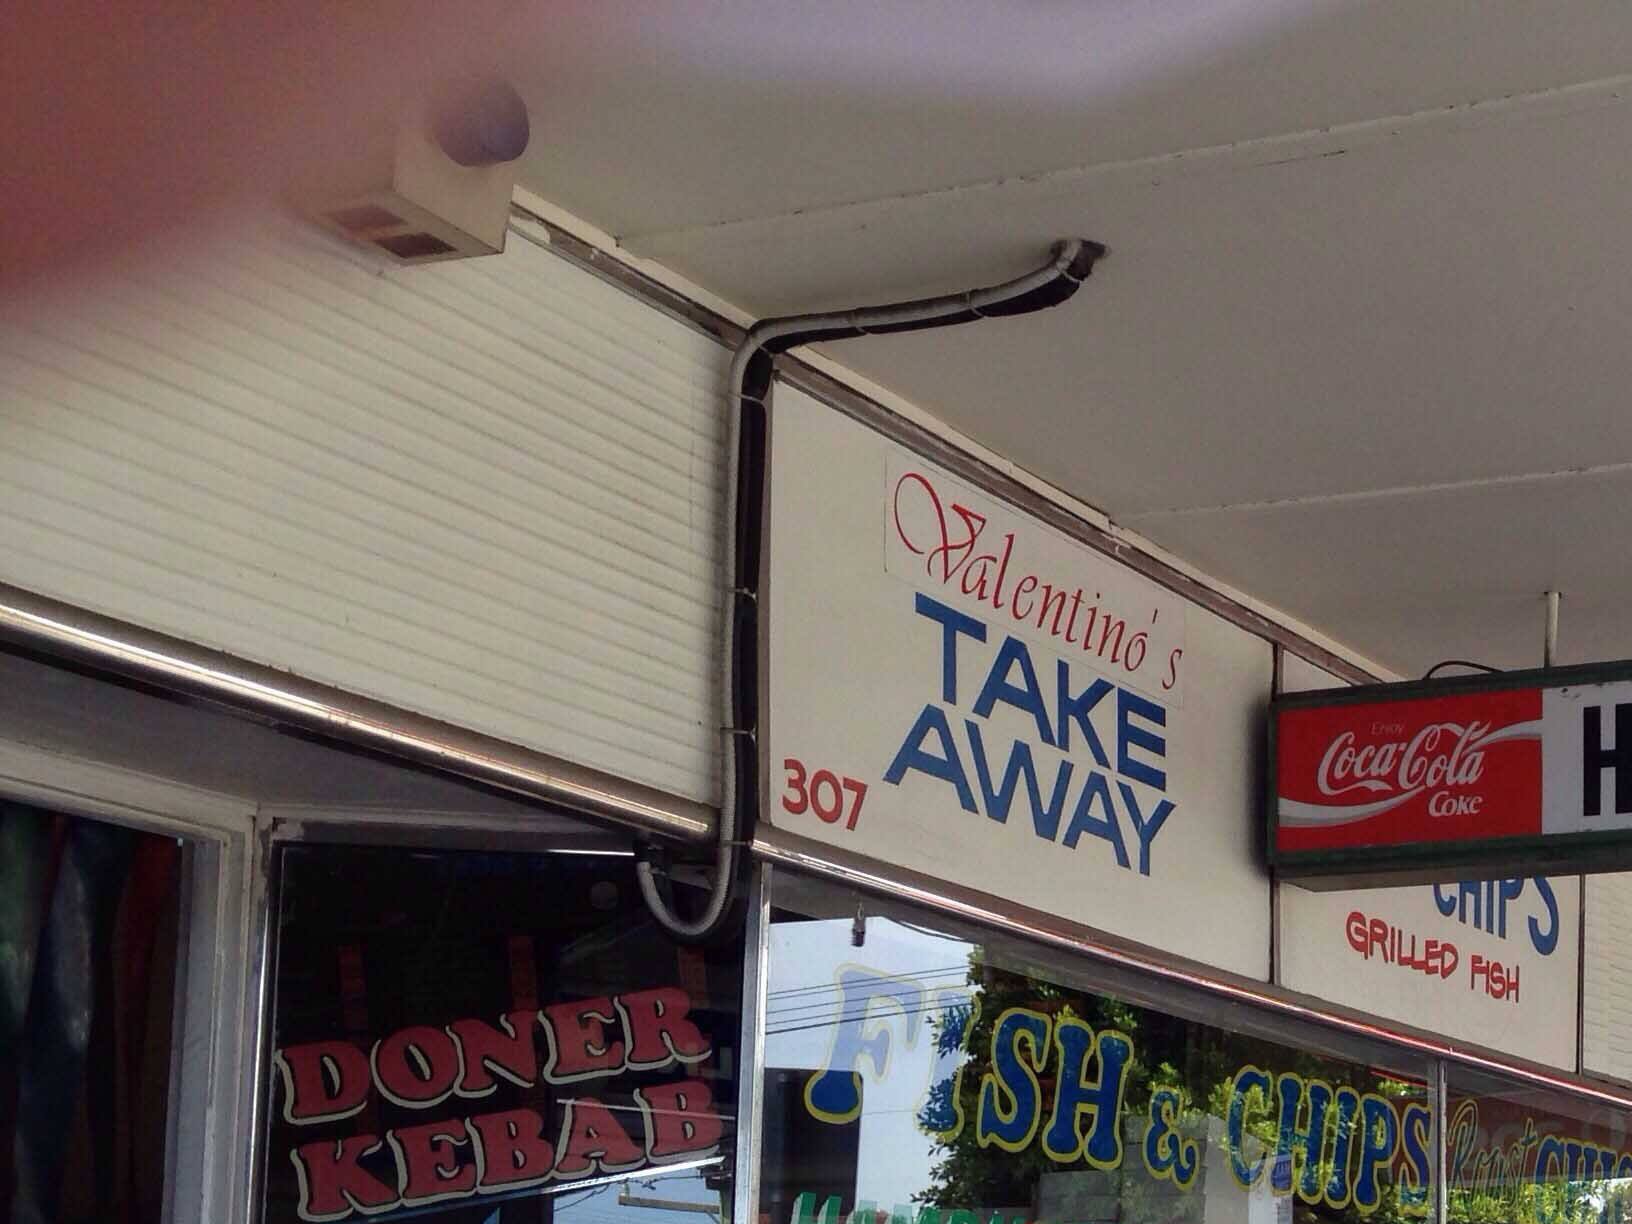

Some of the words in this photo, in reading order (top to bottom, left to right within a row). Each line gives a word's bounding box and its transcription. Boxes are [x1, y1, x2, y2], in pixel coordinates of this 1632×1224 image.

[894, 472, 1182, 690] Valentino's
[915, 591, 1166, 792] TAKE
[1317, 719, 1493, 796] Coca-Cola
[782, 759, 867, 830] 307
[882, 704, 1176, 877] AWAY
[1428, 790, 1482, 818] Coke
[1347, 912, 1459, 979] GRILLED
[1470, 953, 1519, 1002] FISH
[274, 986, 712, 1124] DONER
[804, 962, 1134, 1170] FISH
[1144, 1086, 1198, 1191] &
[1228, 1065, 1434, 1218] CHIPS
[290, 1080, 723, 1224] KEBAB
